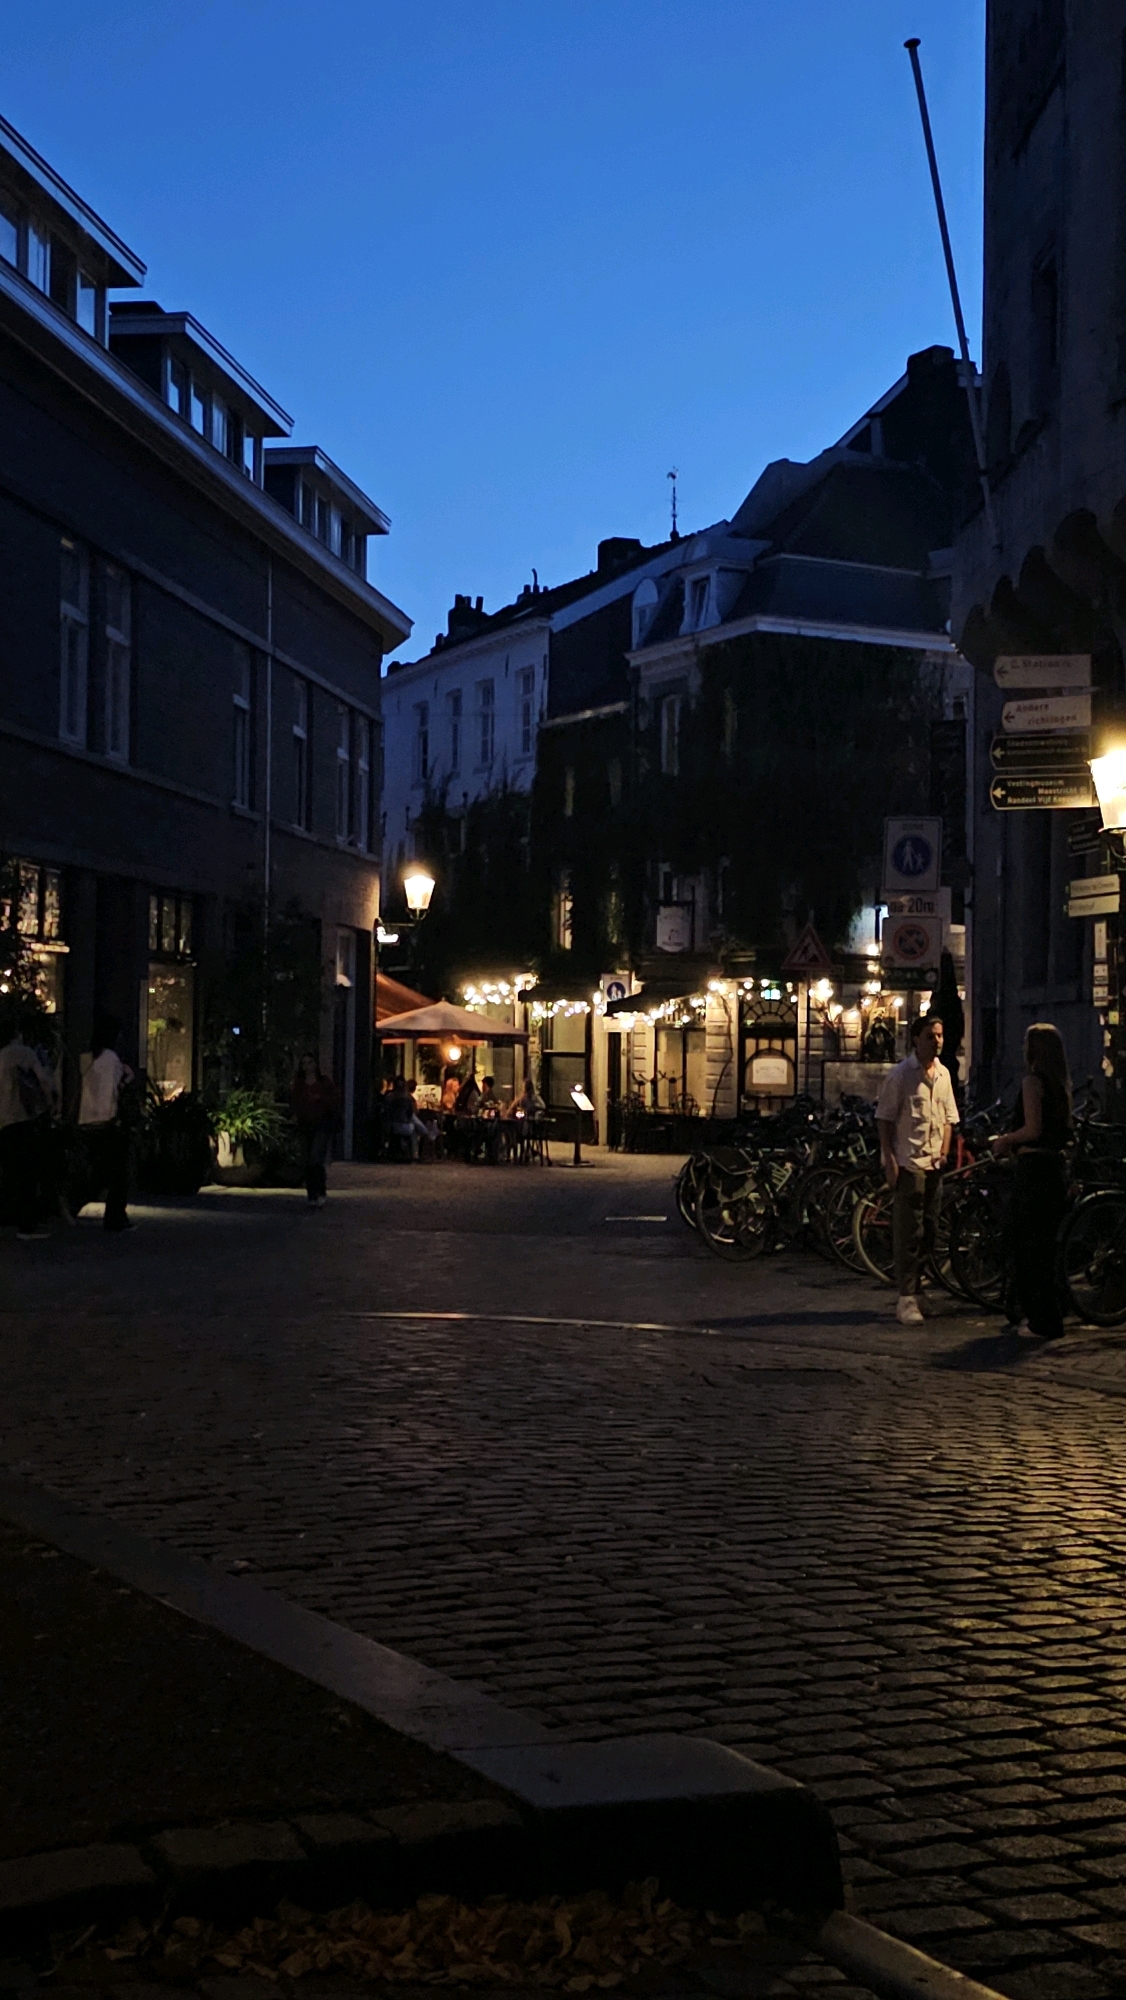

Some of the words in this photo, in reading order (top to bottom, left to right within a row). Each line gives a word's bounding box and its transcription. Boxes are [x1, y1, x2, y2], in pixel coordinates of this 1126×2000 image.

[1022, 659, 1061, 668] Station
[1016, 703, 1050, 713] Andere
[1027, 714, 1078, 725] richtingen
[907, 897, 935, 914] 20m
